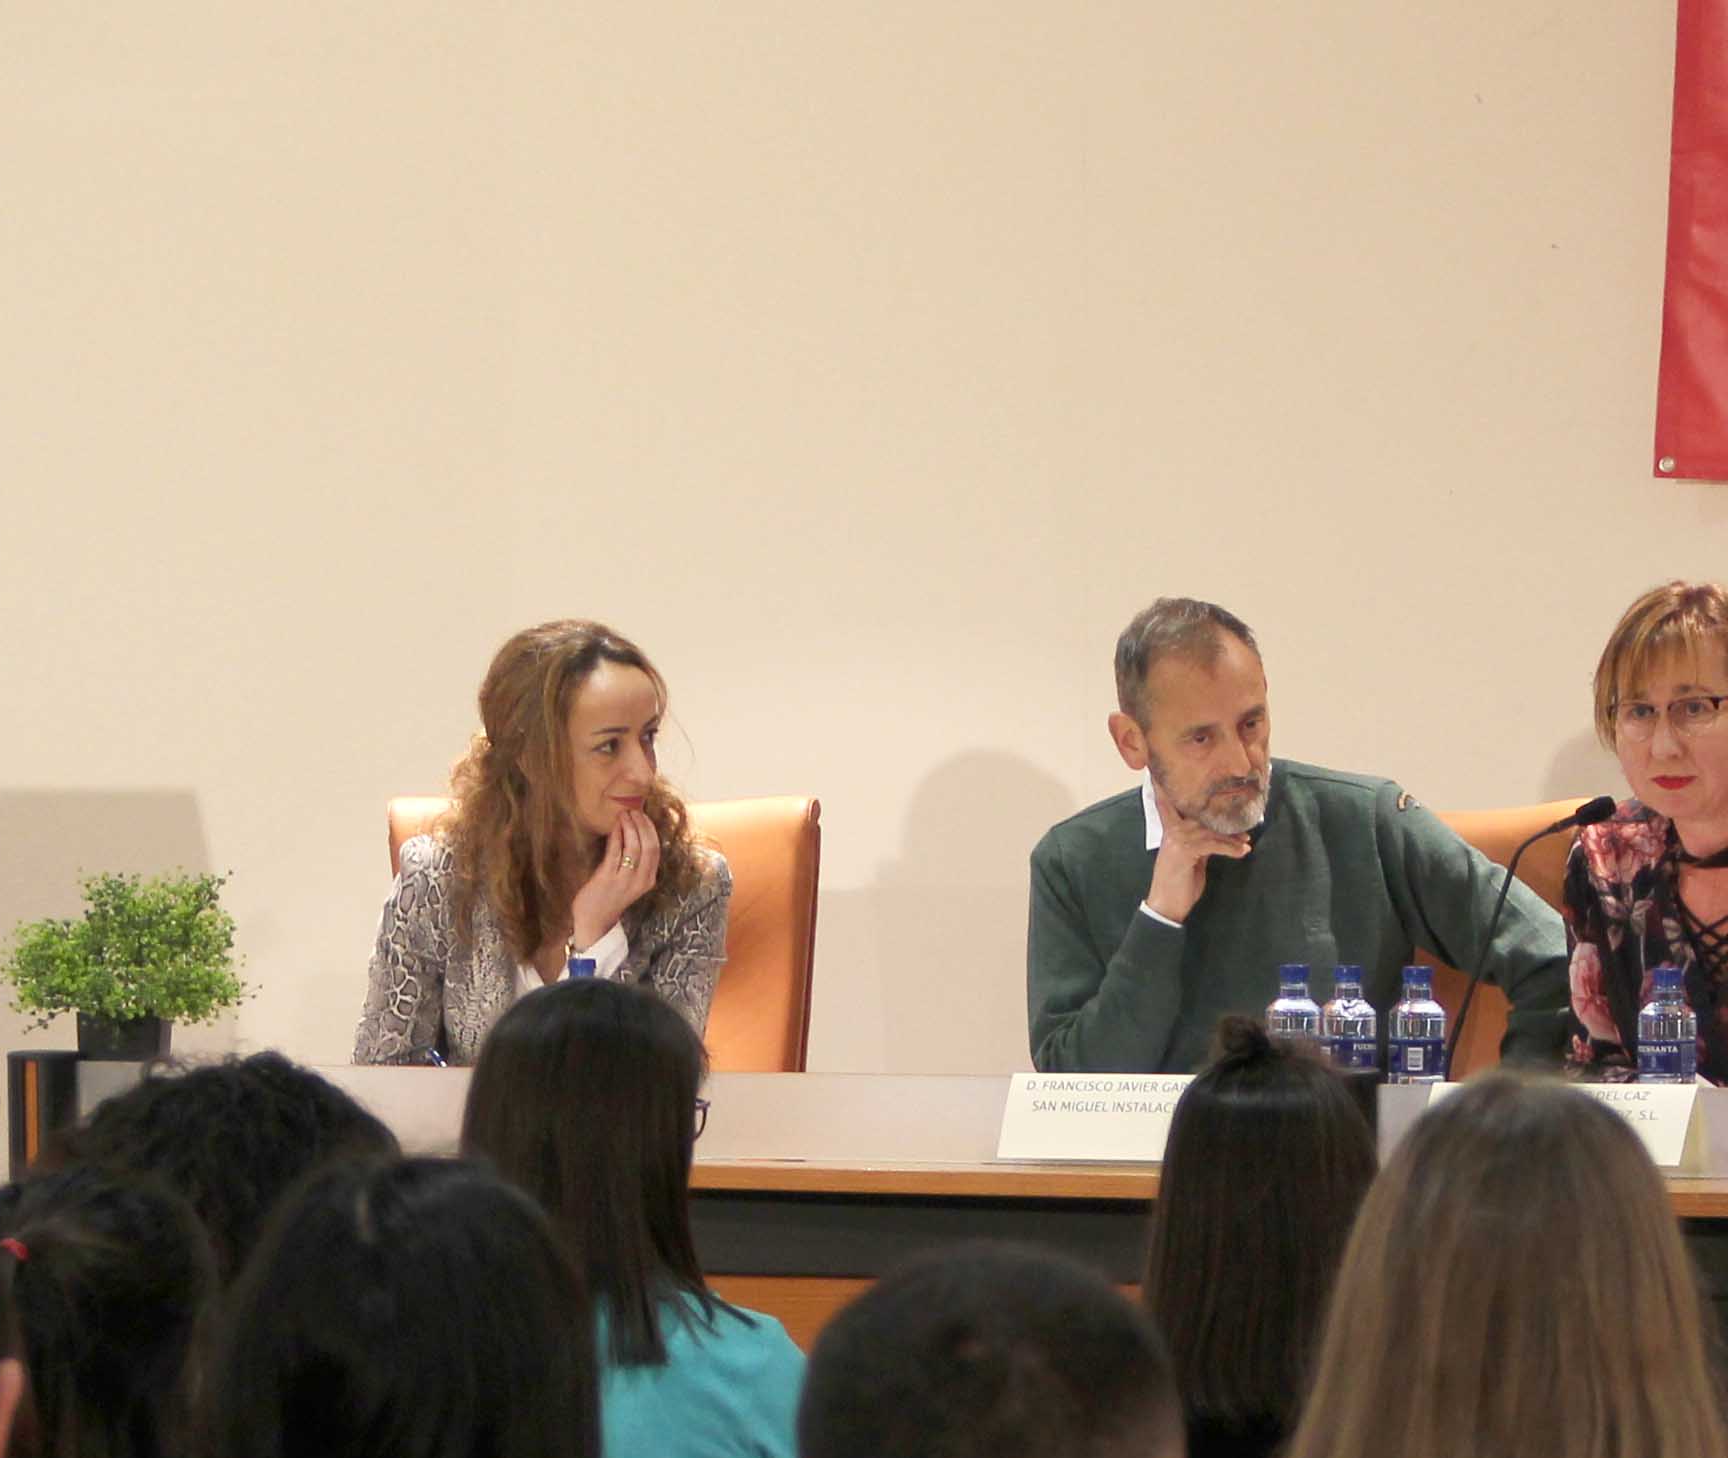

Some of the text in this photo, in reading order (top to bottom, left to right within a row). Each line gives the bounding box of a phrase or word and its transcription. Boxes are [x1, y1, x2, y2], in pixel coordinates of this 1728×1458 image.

[1042, 1080, 1113, 1092] FRANCISCO
[1117, 1080, 1158, 1092] JAVIER
[1031, 1100, 1057, 1112] SAN
[1060, 1100, 1108, 1113] MIGUEL
